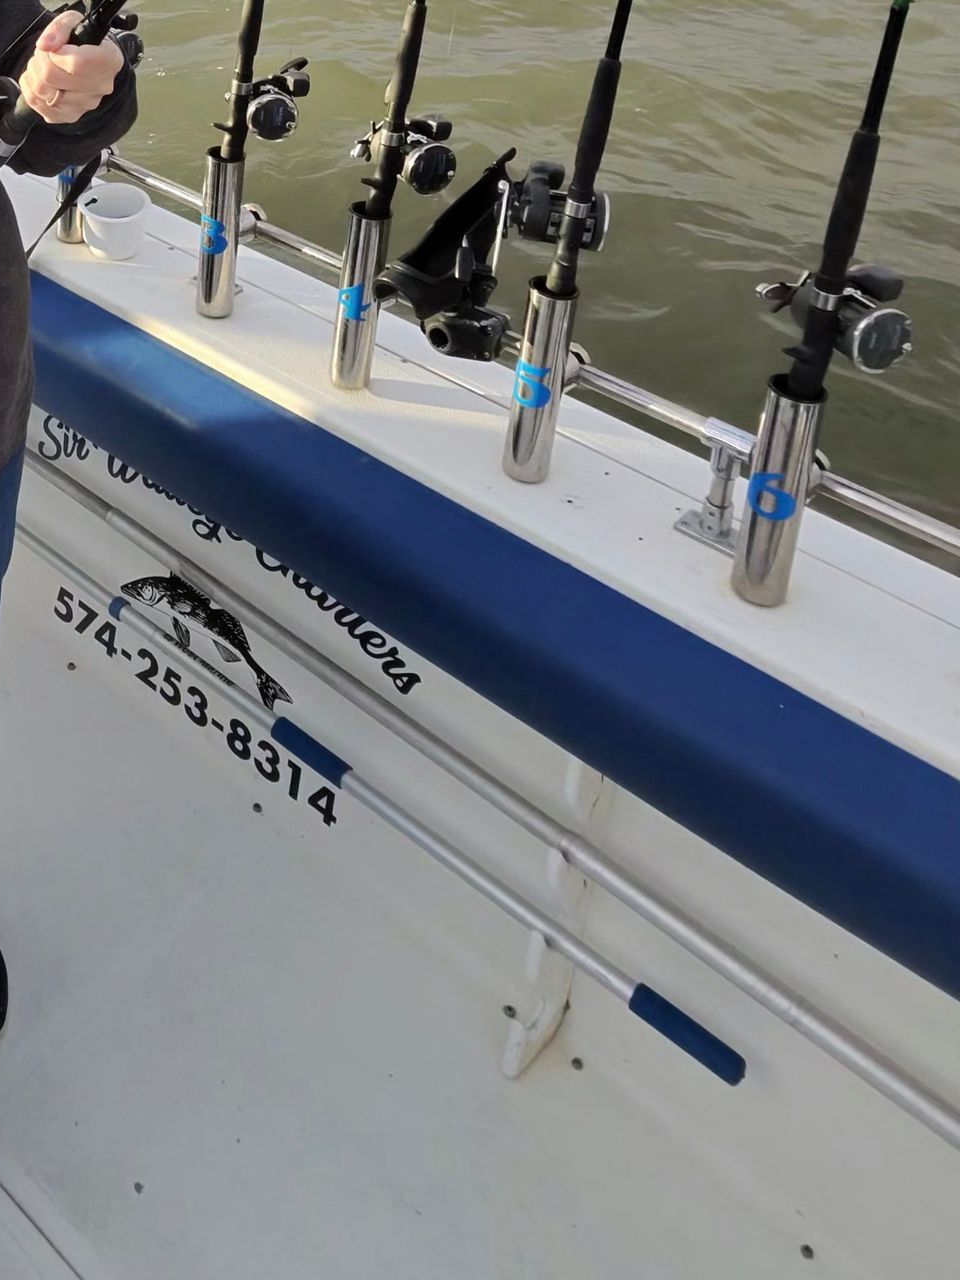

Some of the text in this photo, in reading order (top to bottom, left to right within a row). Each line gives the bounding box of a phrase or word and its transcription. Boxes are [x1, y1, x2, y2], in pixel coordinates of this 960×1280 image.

[201, 214, 228, 255] 3
[338, 283, 372, 322] 4
[514, 359, 552, 409] 5
[38, 414, 90, 462] Sir
[748, 472, 797, 521] 6
[53, 586, 338, 828] 574-253-8314
